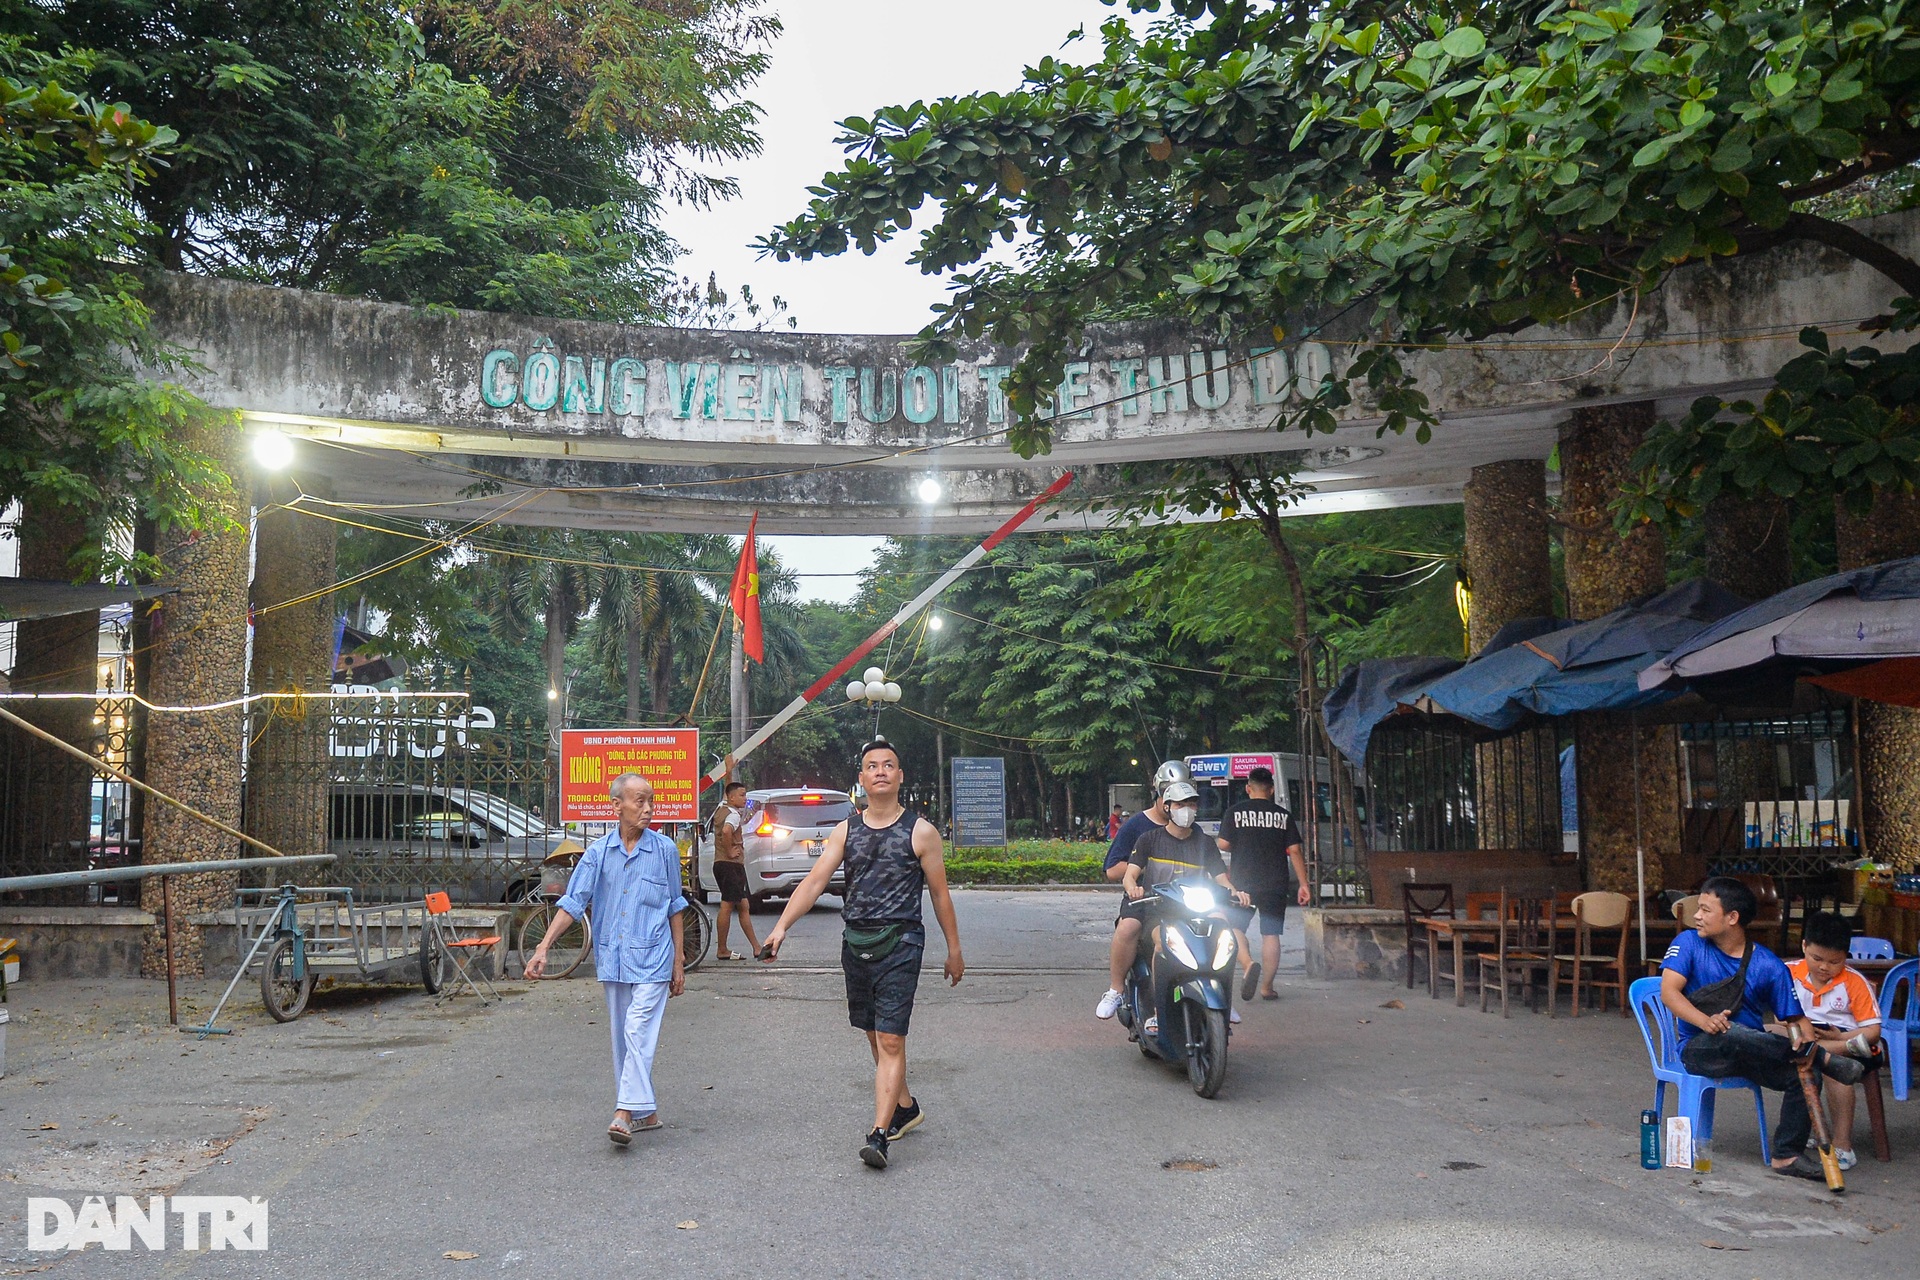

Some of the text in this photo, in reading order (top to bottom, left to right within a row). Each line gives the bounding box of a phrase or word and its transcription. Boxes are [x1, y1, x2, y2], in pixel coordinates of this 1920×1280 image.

[481, 336, 647, 417] CÔNG
[665, 348, 800, 423] VIÊN
[583, 736, 602, 745] UBND
[603, 735, 632, 745] PHƯỜNG
[632, 736, 655, 745] THANH
[636, 749, 648, 760] CÁC
[673, 749, 687, 762] TIỆN
[569, 751, 601, 784] KHÔNG
[607, 765, 622, 775] GIAO
[642, 764, 656, 775] TRÁI
[1190, 762, 1227, 772] DEWEY
[567, 793, 611, 802] TRONG CÔN
[682, 792, 693, 802] ĐÔ
[1233, 810, 1289, 831] PARADOX
